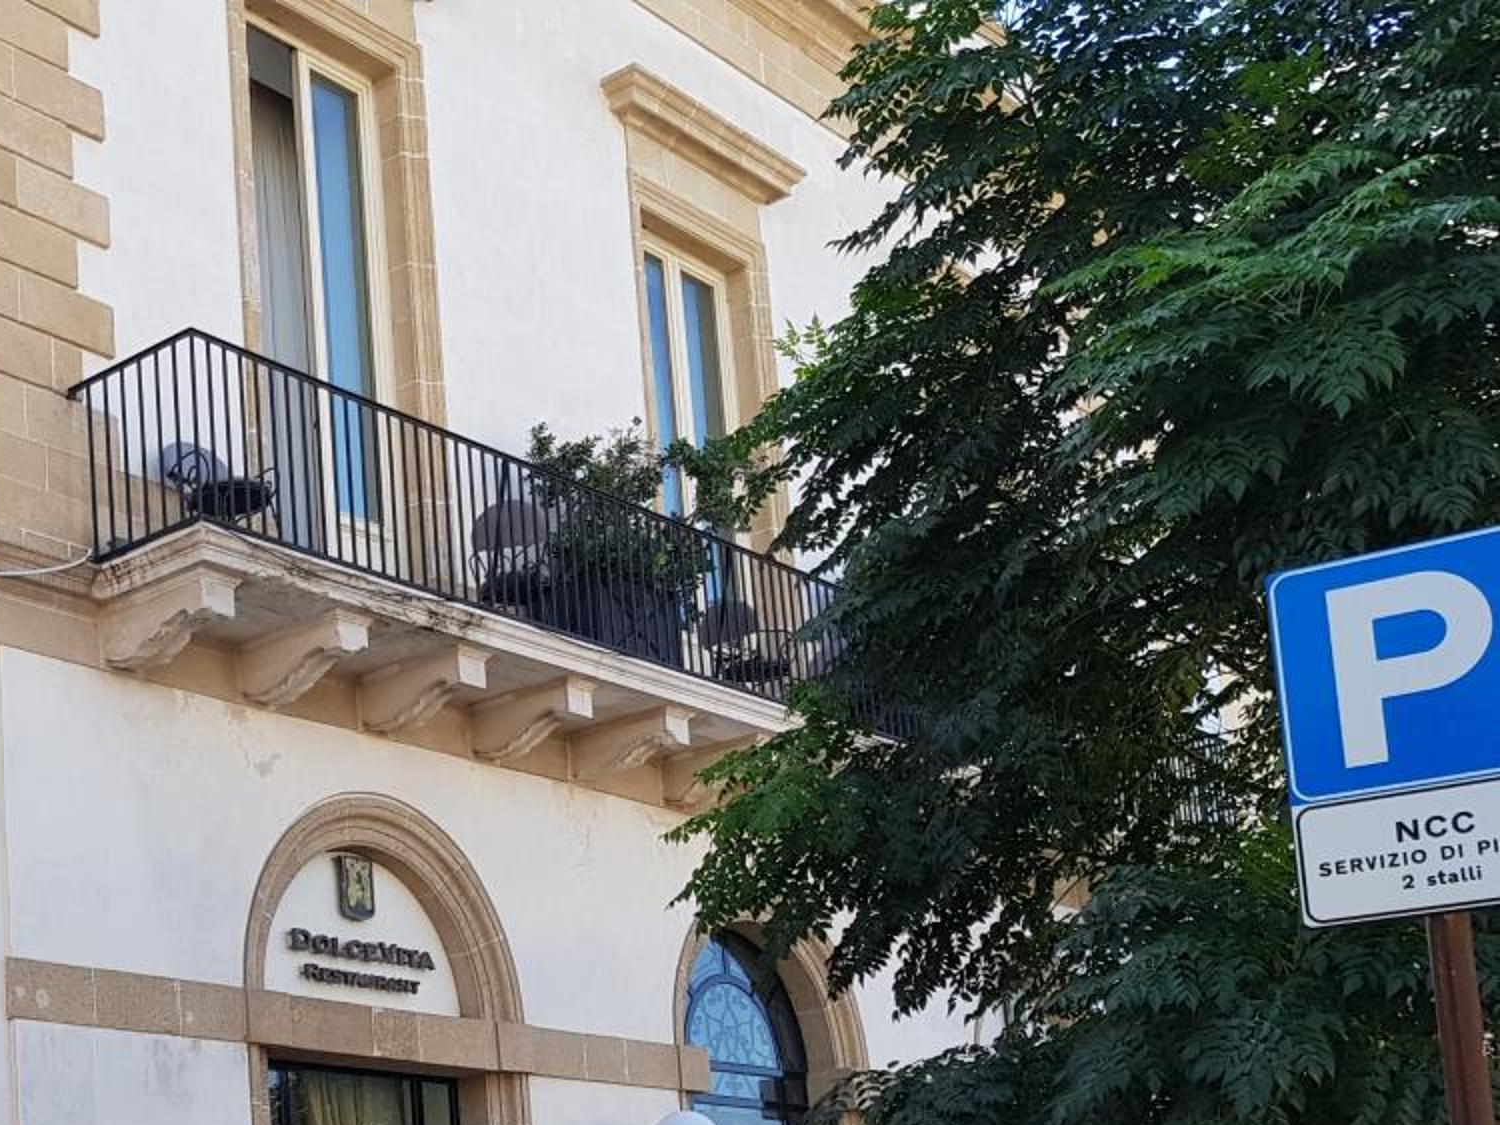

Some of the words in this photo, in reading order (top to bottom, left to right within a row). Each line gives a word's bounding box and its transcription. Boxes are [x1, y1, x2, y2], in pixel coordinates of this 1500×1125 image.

[1325, 571, 1493, 768] P
[1395, 811, 1475, 842] NCC
[1319, 849, 1427, 877] SERVIZIO
[1440, 844, 1463, 860] DI
[1402, 875, 1415, 889] 2
[1427, 865, 1483, 886] stalli
